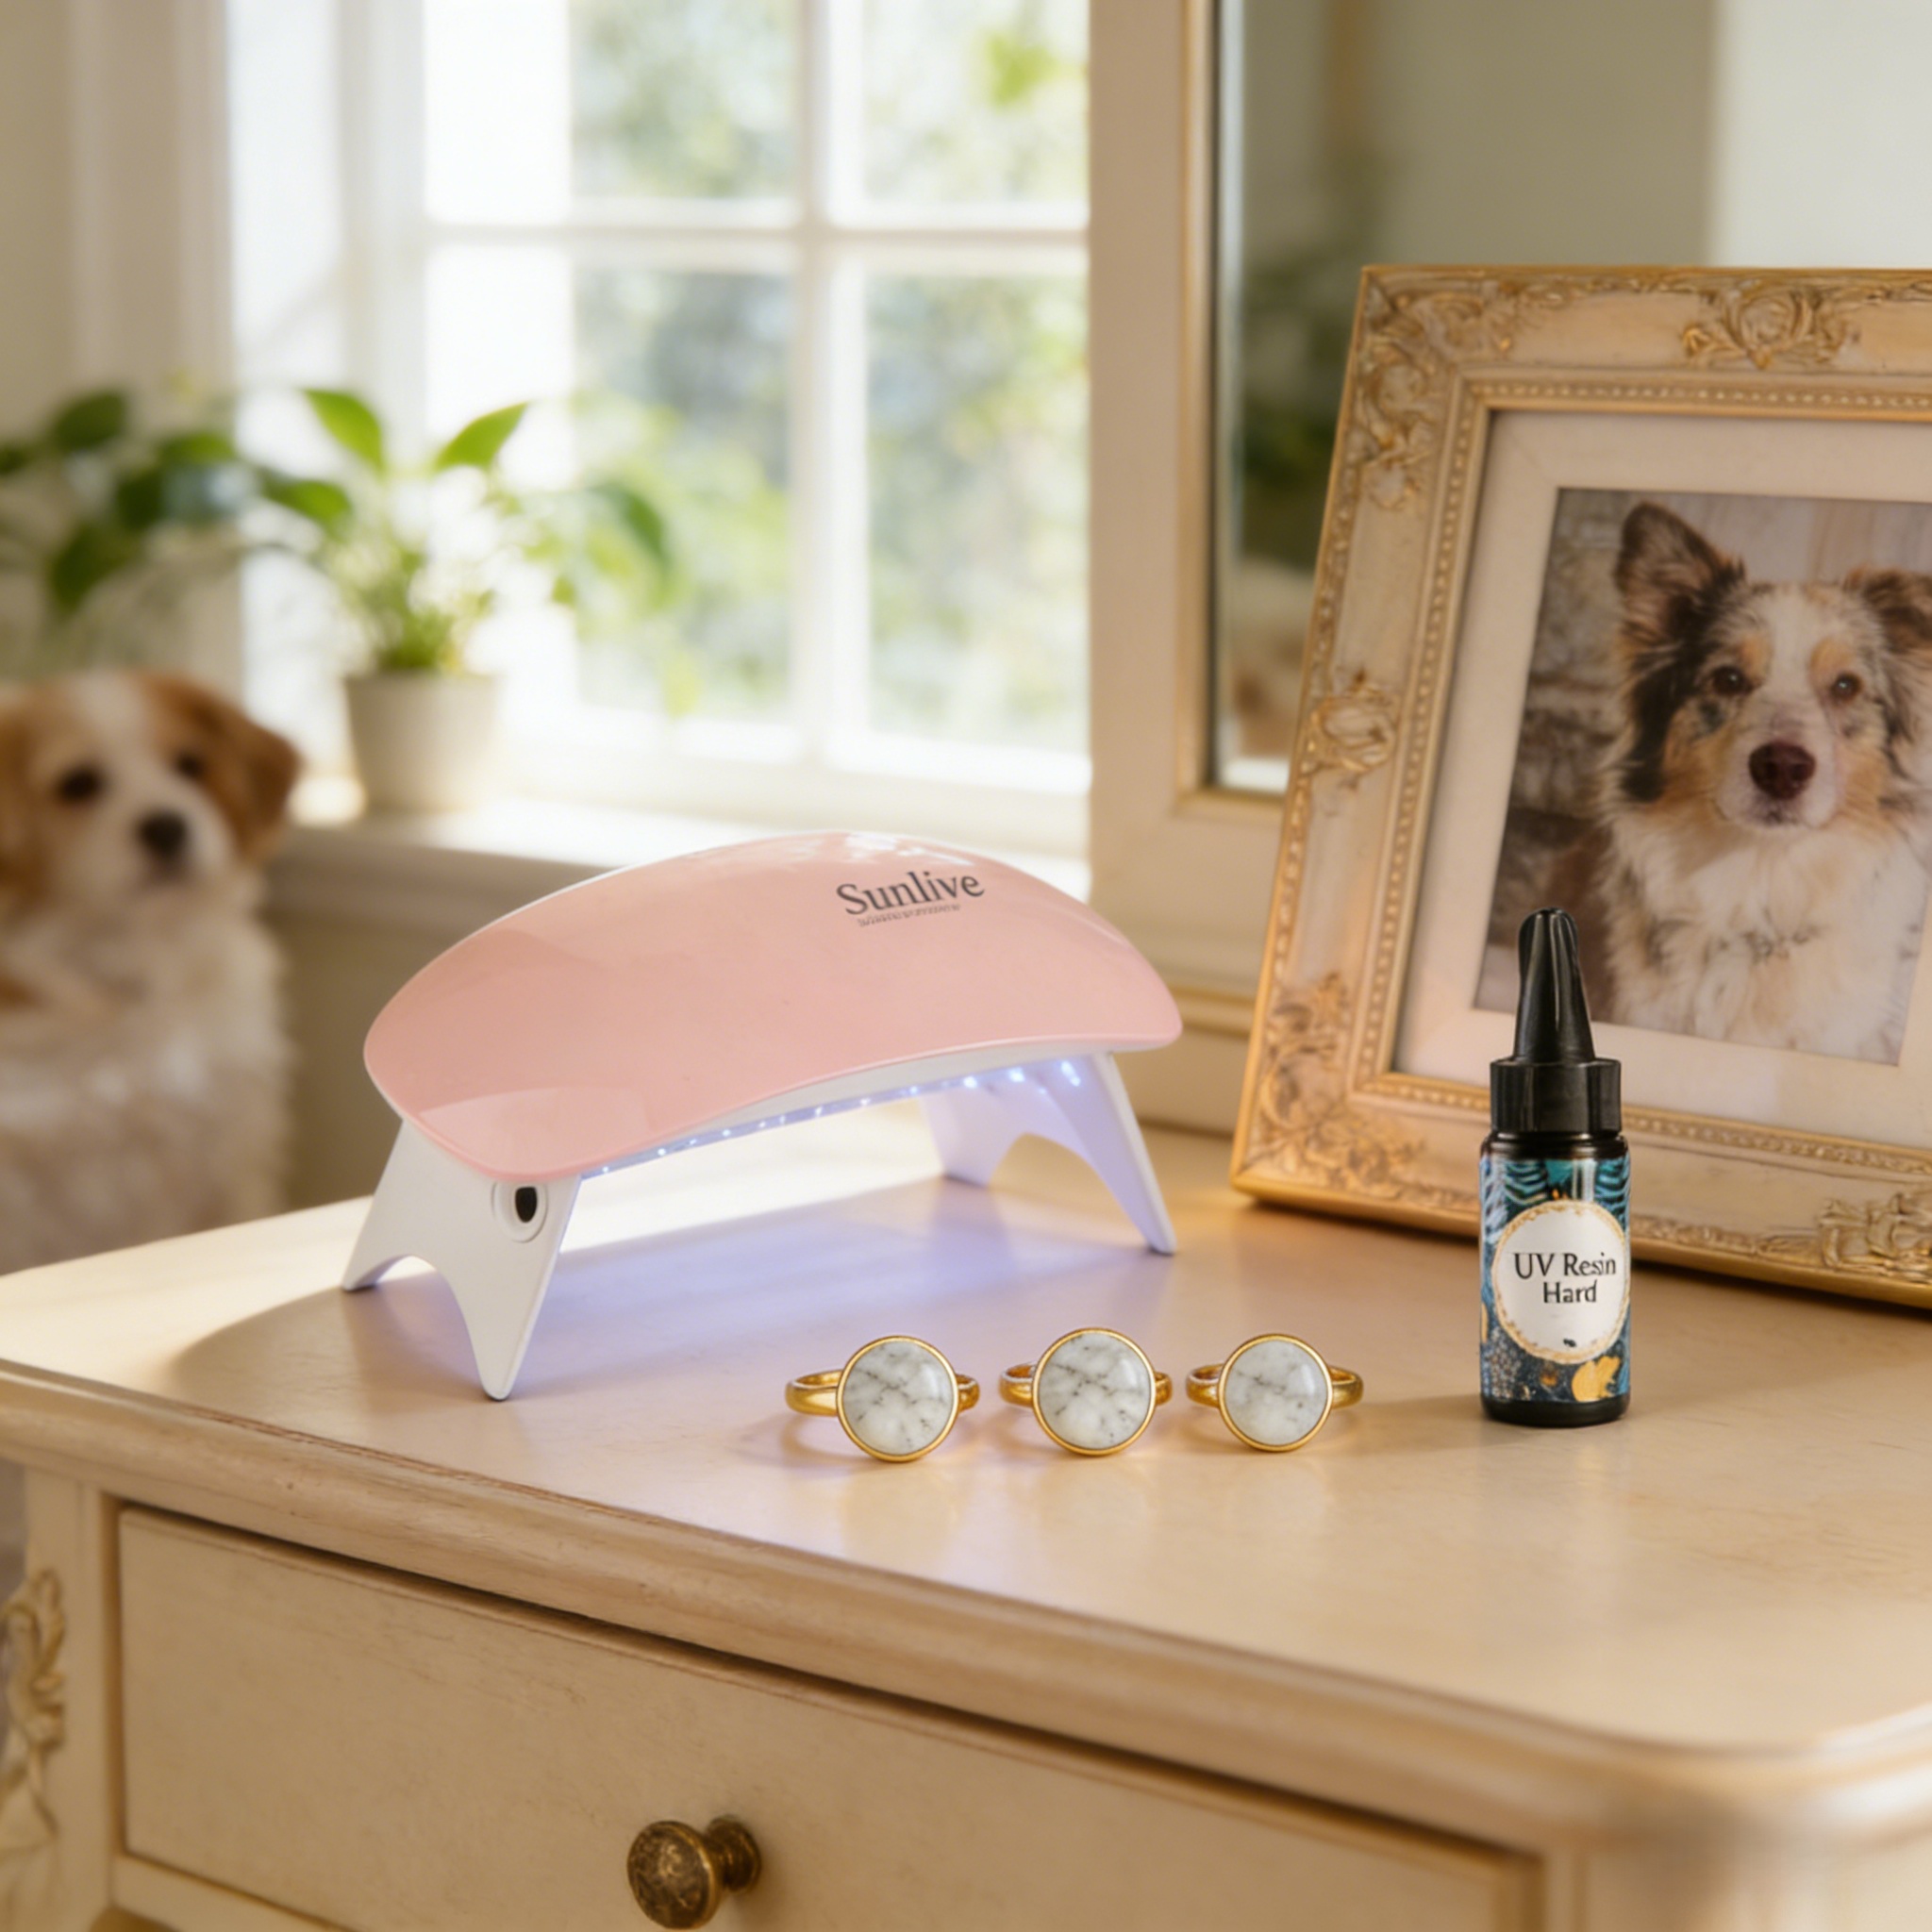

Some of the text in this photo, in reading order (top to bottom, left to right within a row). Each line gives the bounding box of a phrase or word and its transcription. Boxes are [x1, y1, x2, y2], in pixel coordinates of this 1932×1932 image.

[836, 871, 985, 915] Sunlive
[1513, 1252, 1616, 1280] UV Resin
[1542, 1279, 1597, 1304] Hard
